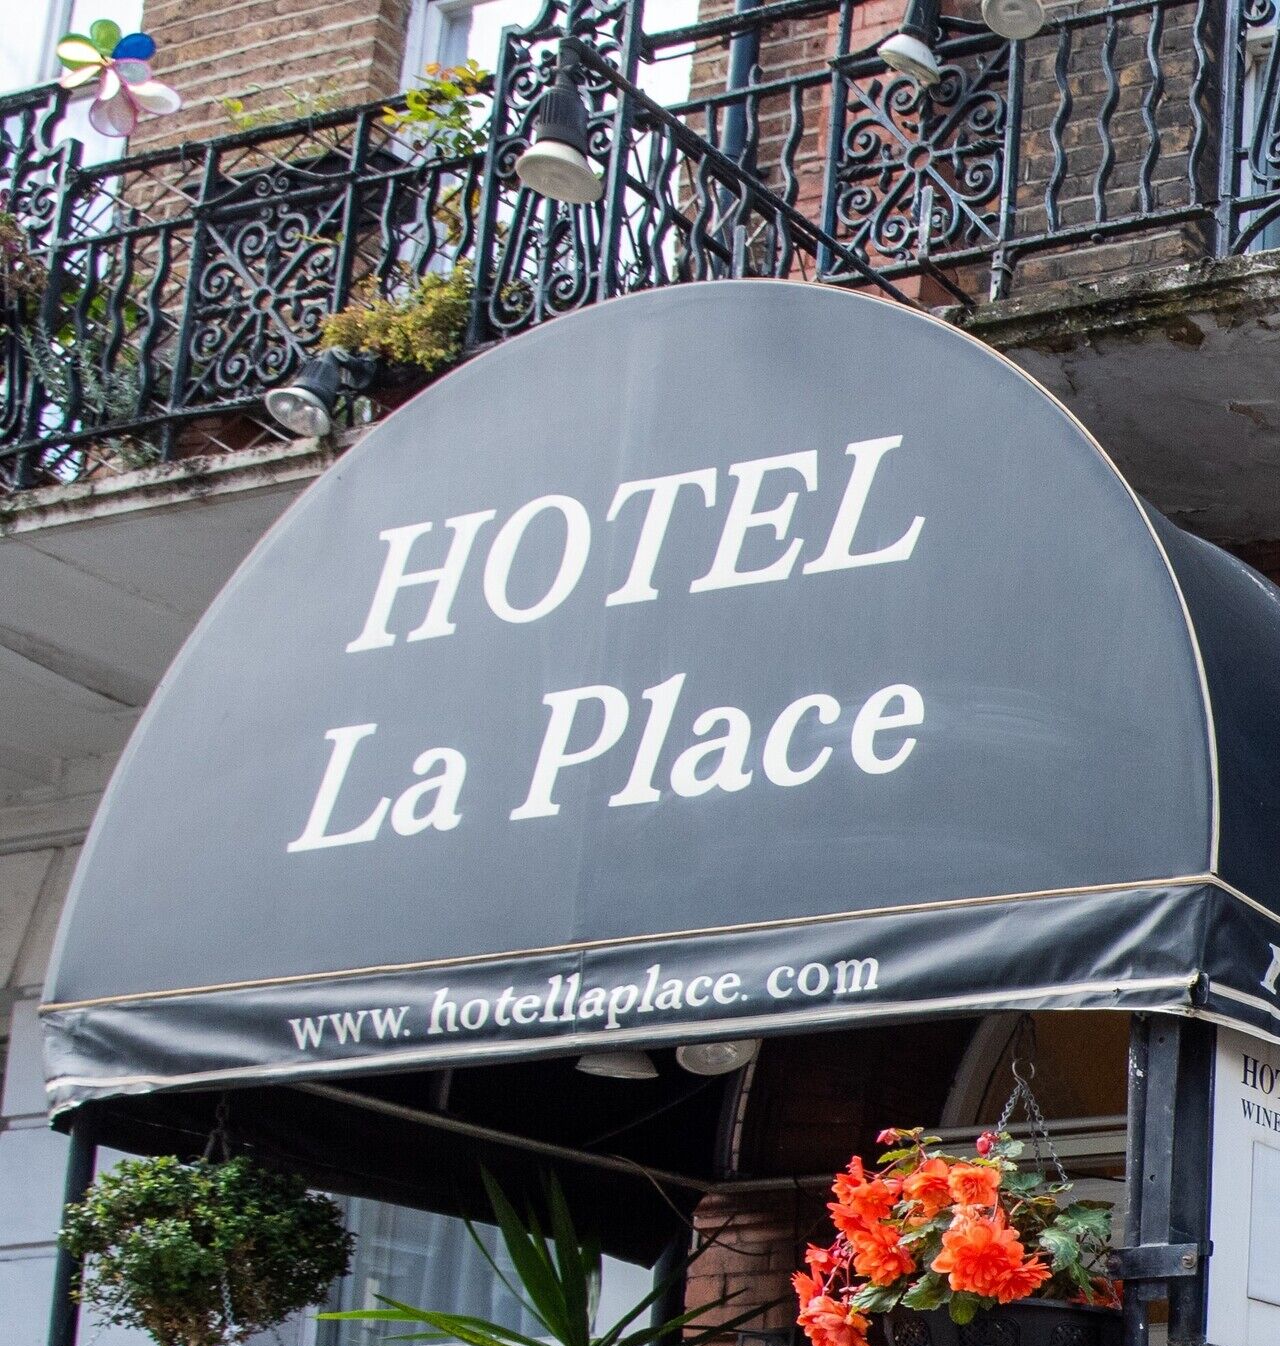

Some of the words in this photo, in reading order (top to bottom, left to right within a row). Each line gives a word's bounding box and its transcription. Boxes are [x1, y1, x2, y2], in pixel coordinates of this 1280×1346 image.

[345, 434, 926, 654] HOTEL
[286, 722, 467, 854] La
[508, 672, 925, 821] Place
[288, 1005, 411, 1050] www.
[427, 964, 748, 1035] hotellaplace.
[766, 957, 879, 998] com
